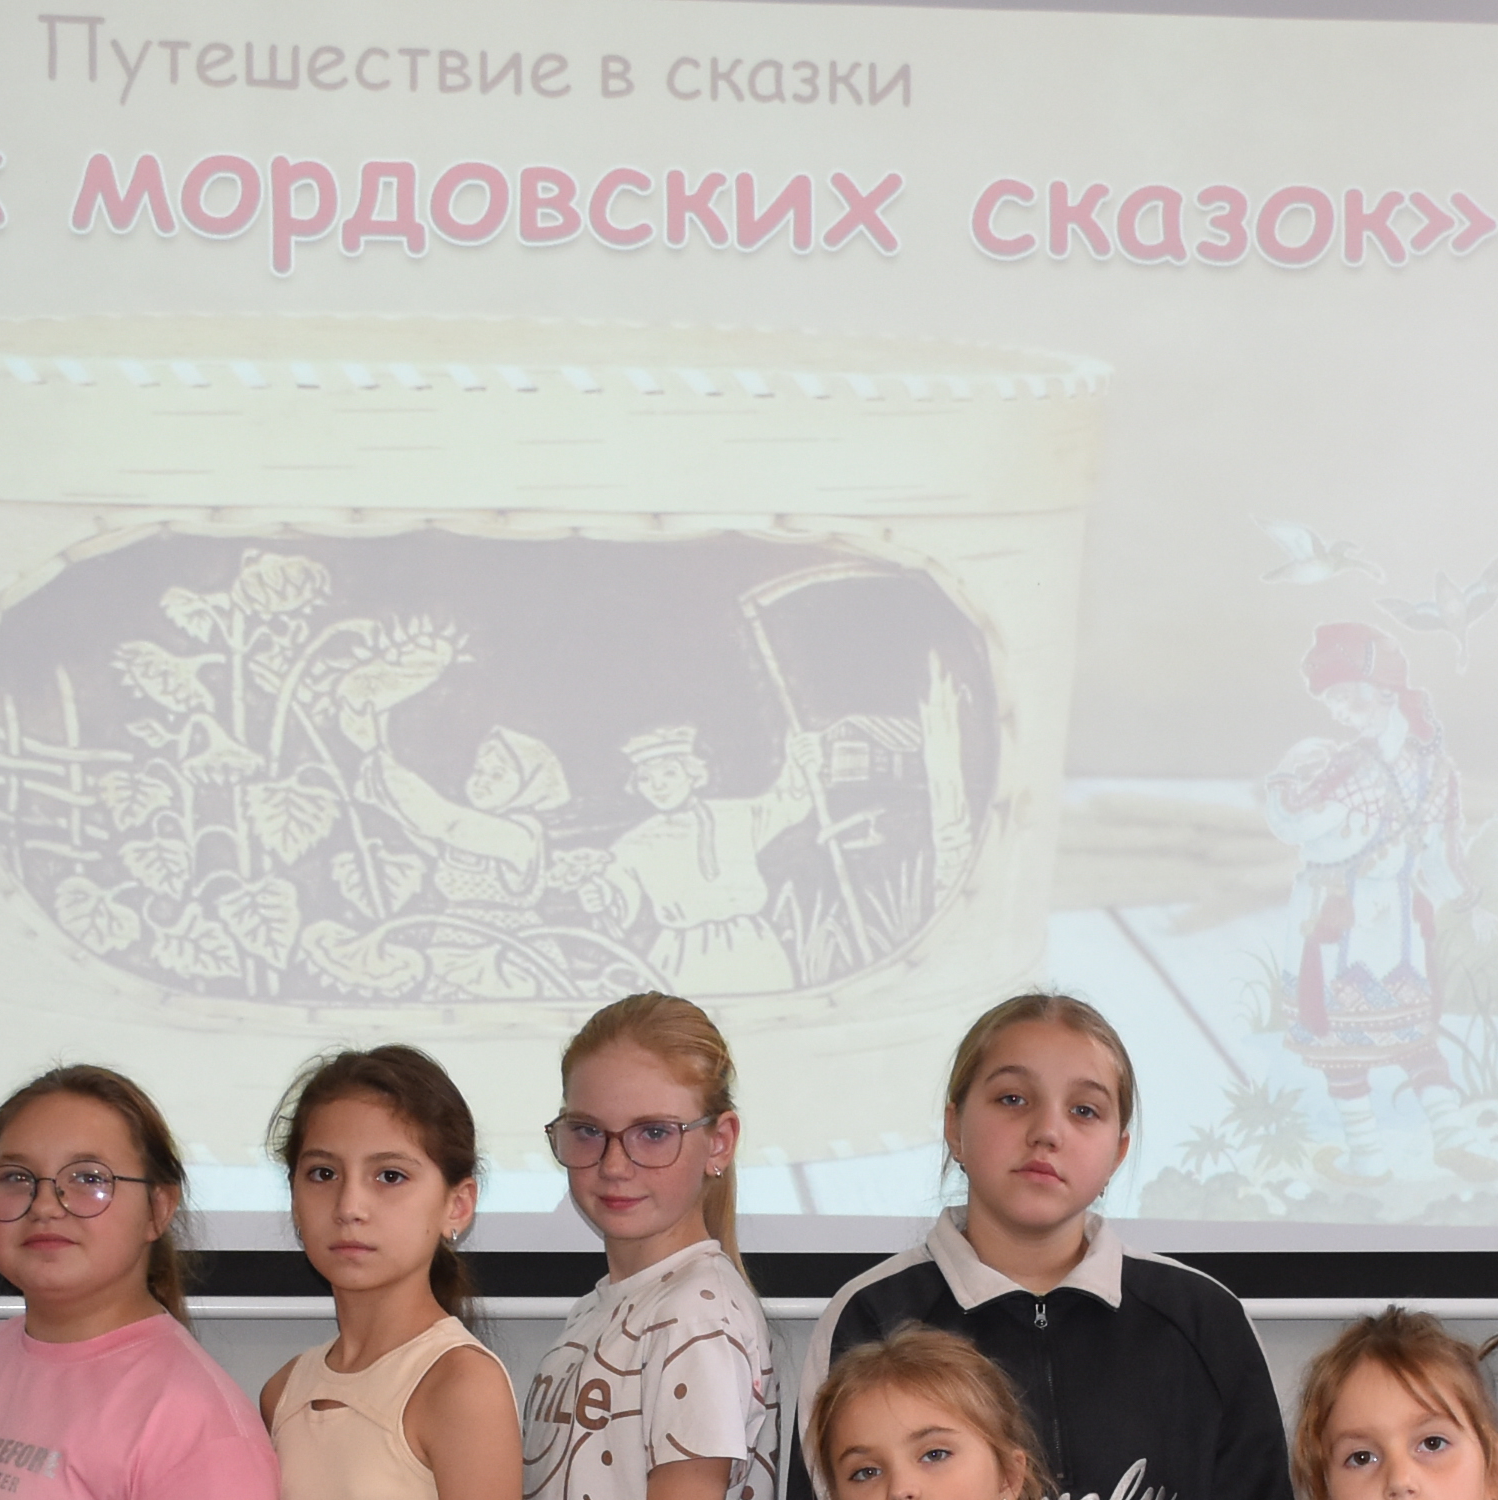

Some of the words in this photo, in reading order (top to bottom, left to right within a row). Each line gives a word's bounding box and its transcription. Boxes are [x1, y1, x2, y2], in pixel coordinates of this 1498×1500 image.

[38, 13, 572, 107] Путешествие
[600, 53, 635, 98] в
[666, 54, 912, 107] сказки
[69, 150, 903, 274] мордовских
[970, 177, 1498, 268] сказок»
